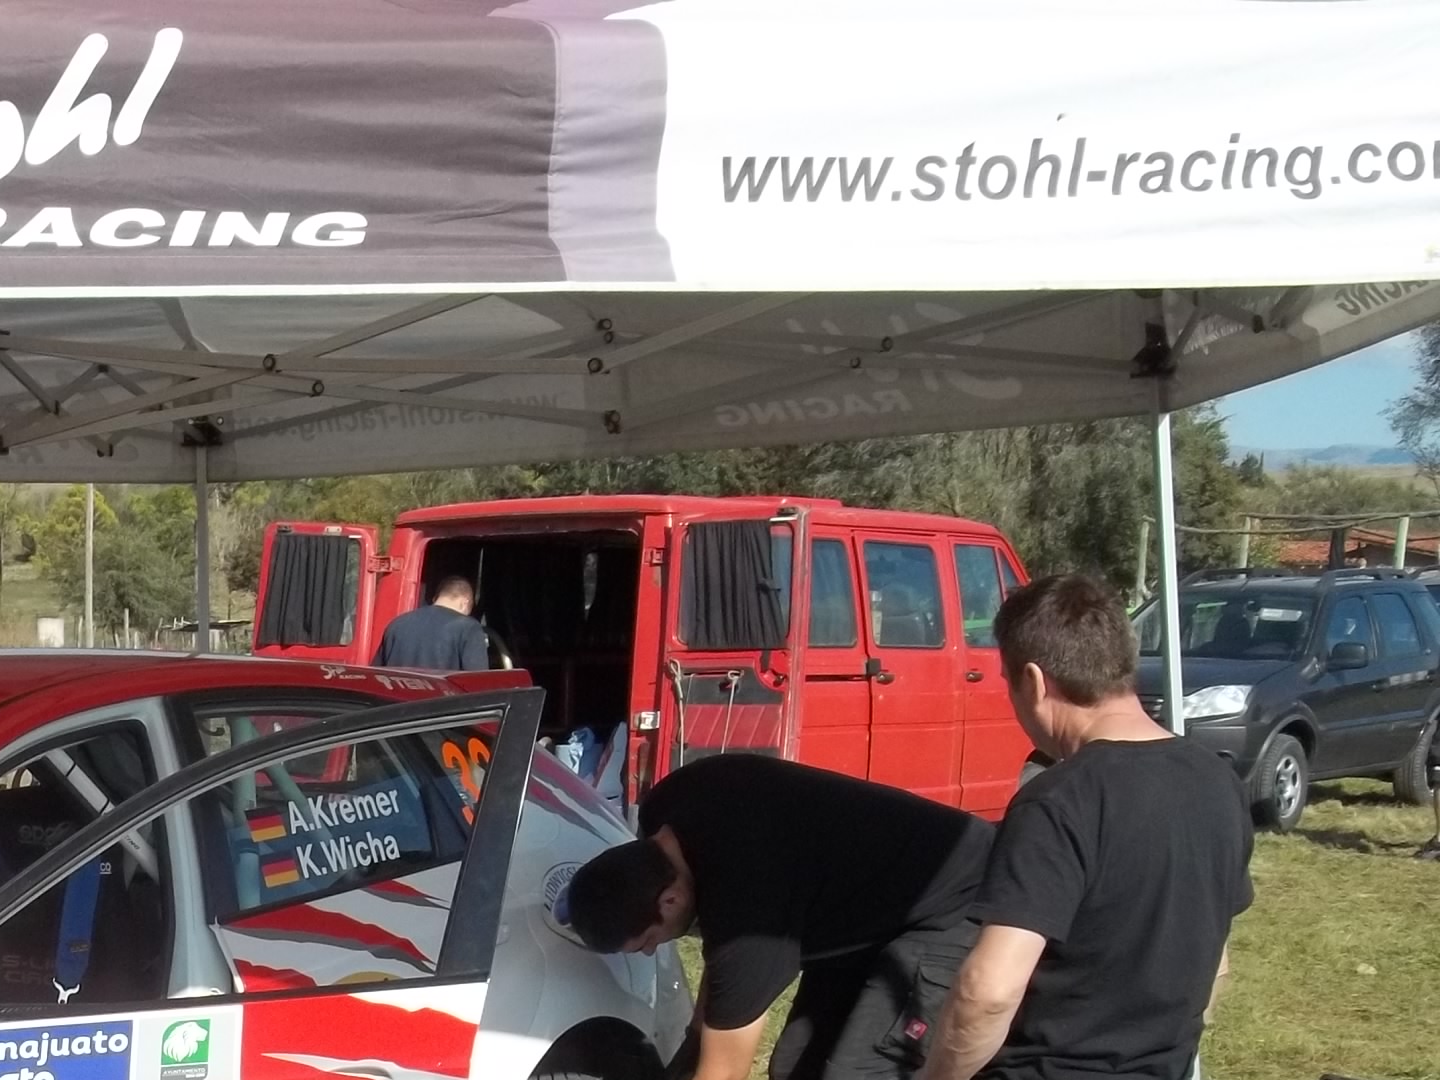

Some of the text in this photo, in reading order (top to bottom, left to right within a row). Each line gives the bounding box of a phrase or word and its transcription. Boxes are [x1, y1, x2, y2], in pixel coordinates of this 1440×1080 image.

[720, 132, 1440, 204] www.stohl-racing.co
[287, 787, 401, 835] A.Kremer
[296, 831, 401, 880] K.Wicha
